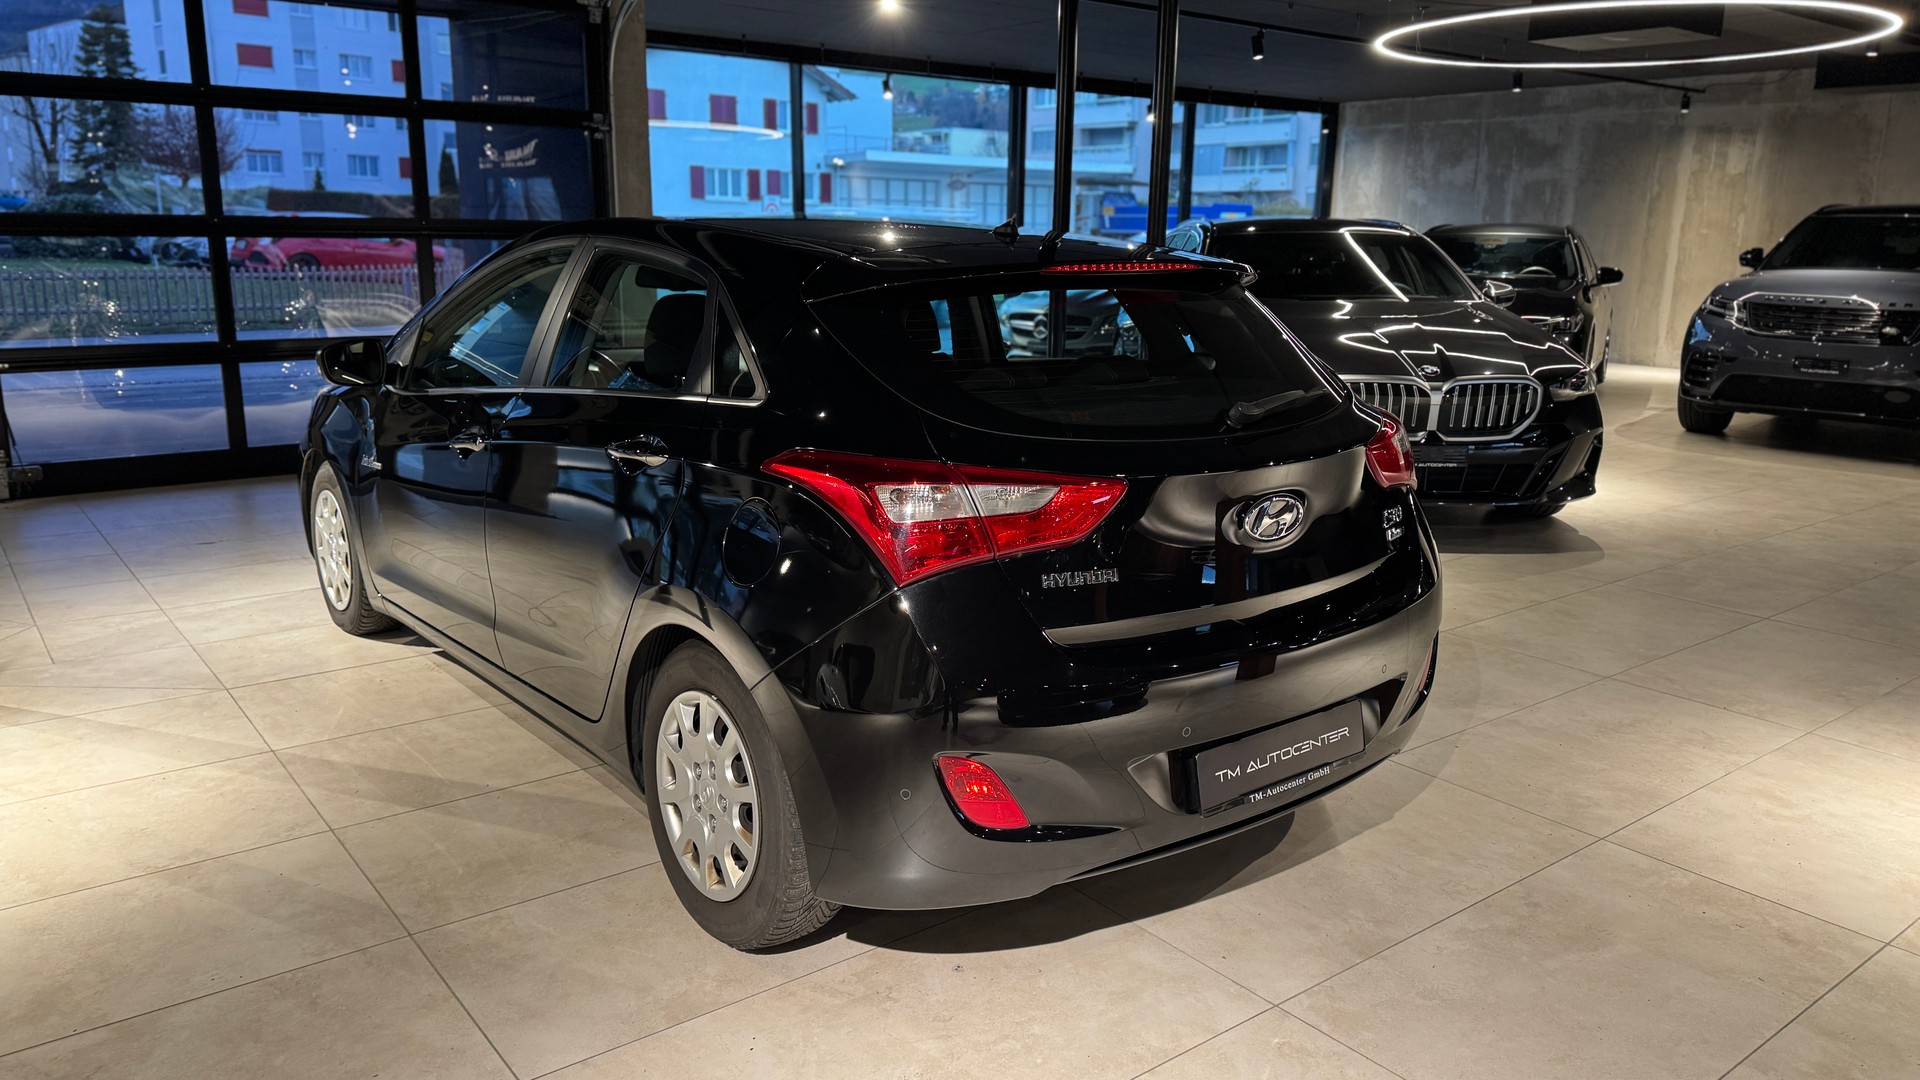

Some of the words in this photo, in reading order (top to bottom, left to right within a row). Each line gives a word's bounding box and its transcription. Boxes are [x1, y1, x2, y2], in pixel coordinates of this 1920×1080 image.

[1041, 567, 1119, 589] HYUNDAI
[1215, 764, 1241, 783] TM
[1246, 727, 1350, 773] AUTOCENTER
[1249, 777, 1306, 803] TM-Autocenter
[1308, 766, 1330, 781] GmbH
